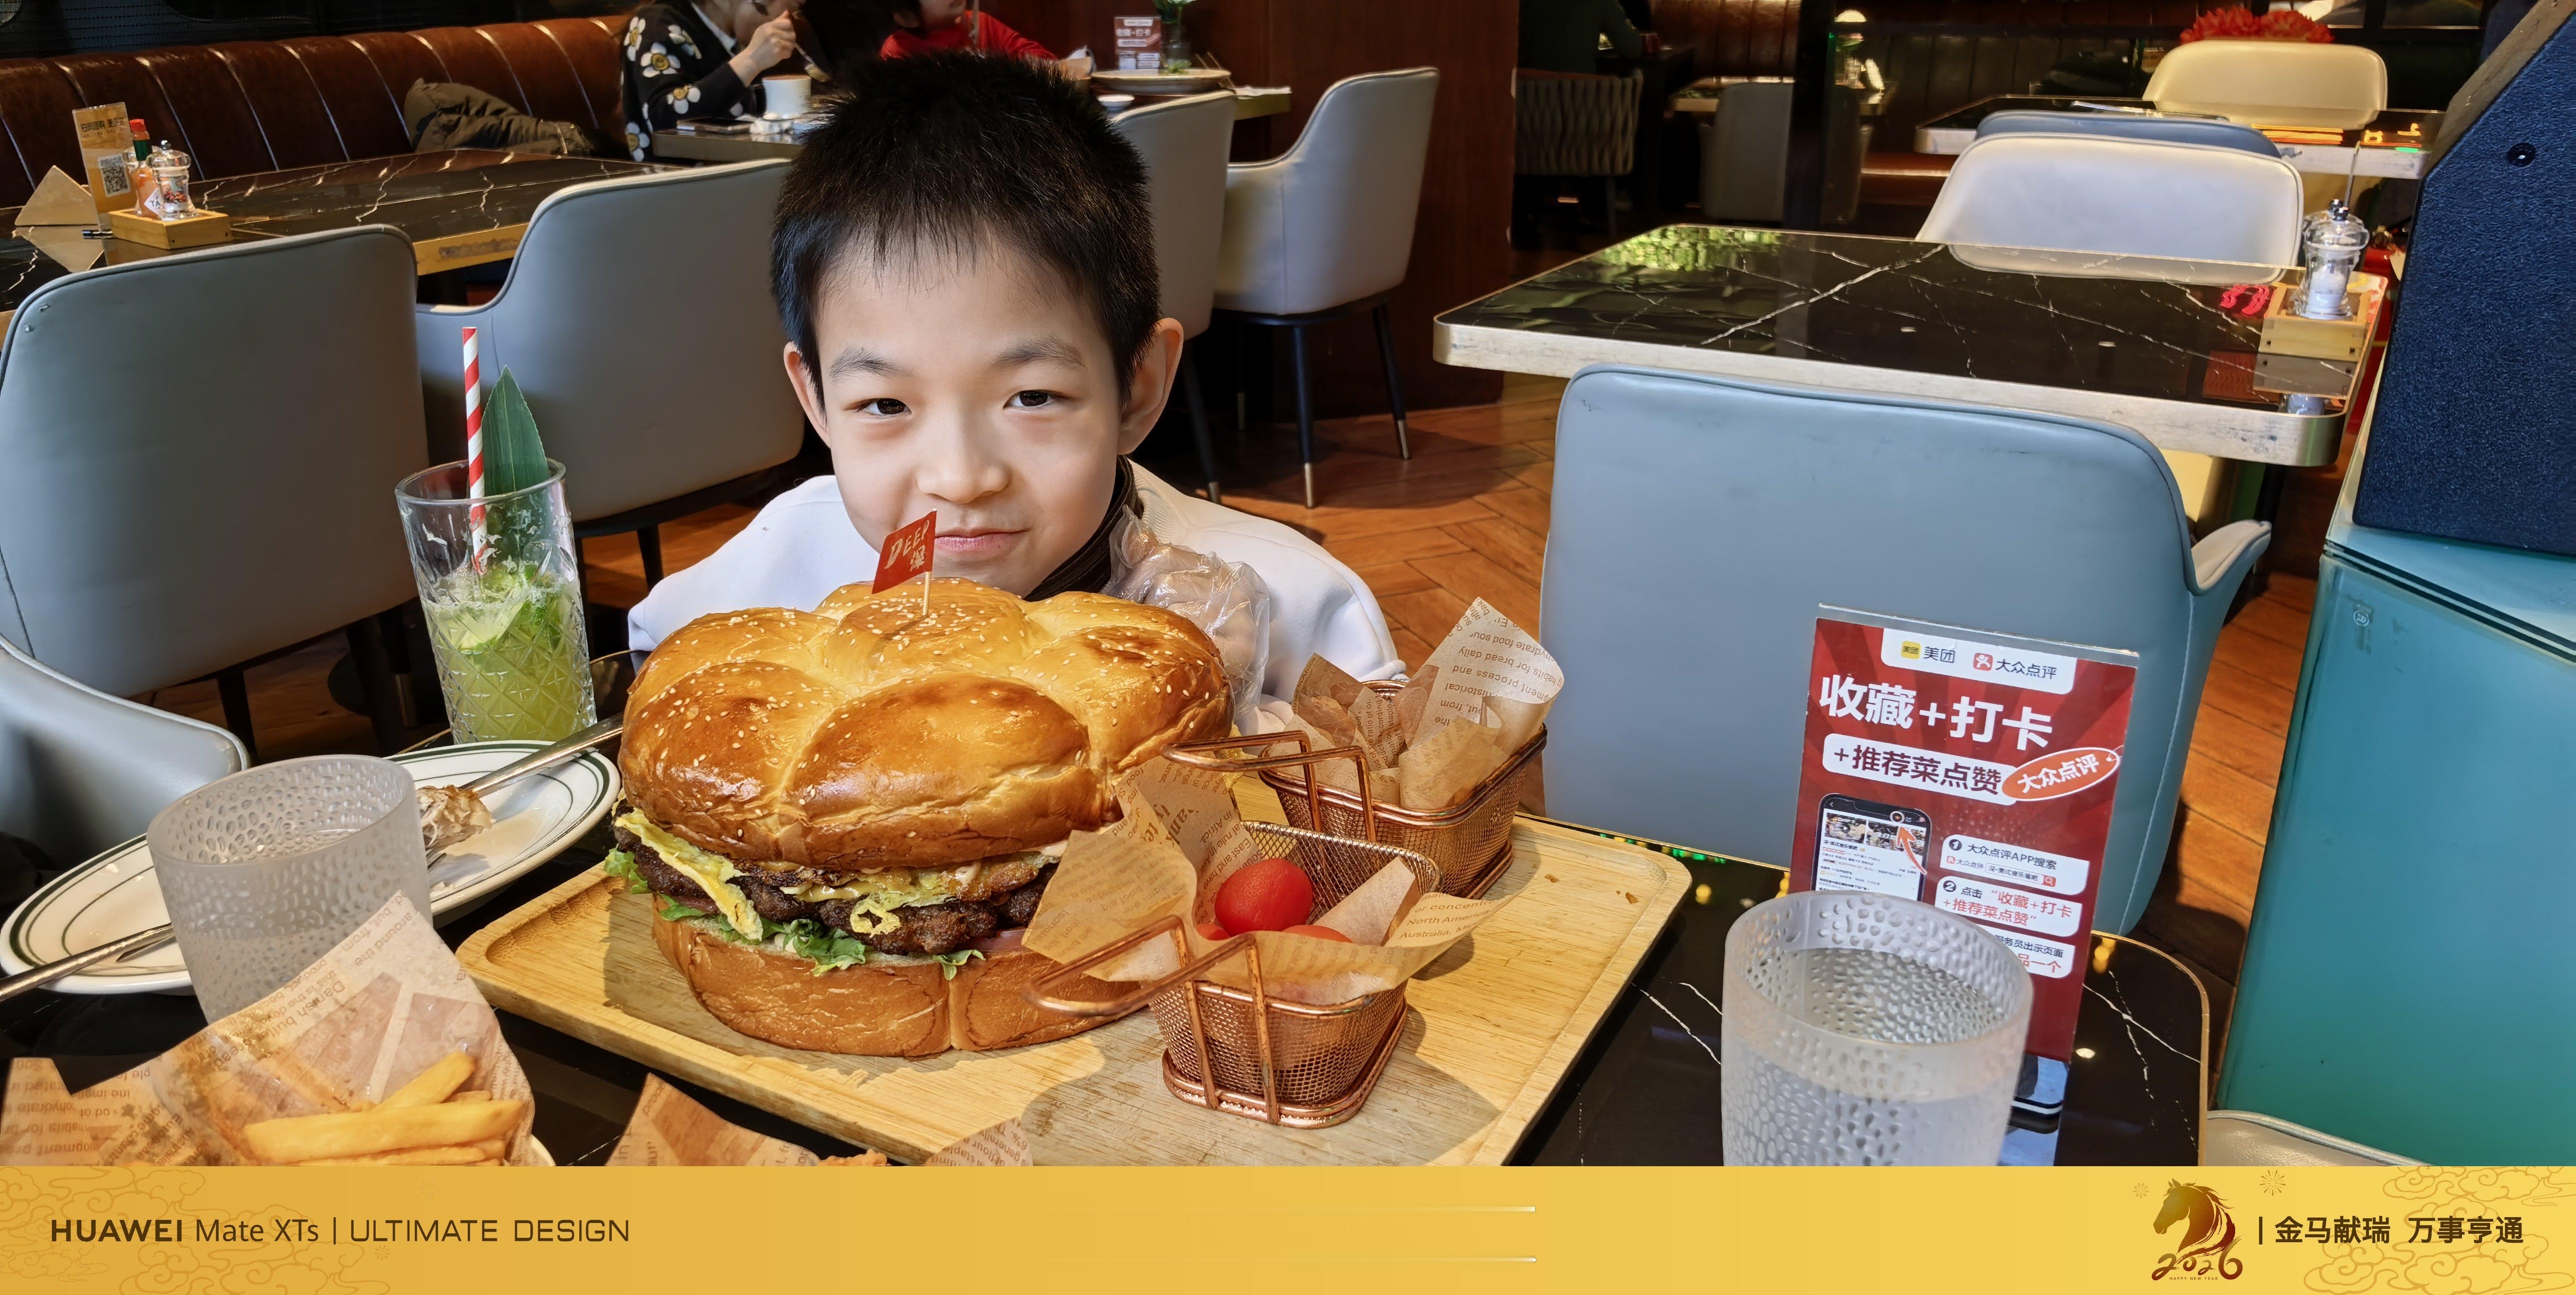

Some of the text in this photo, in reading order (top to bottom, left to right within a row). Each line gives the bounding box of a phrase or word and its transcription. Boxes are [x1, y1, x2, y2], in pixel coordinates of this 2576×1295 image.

[1491, 635, 1514, 648] food
[1452, 664, 1473, 676] and
[1457, 645, 1558, 685] habits for bread daily
[1924, 646, 1955, 663] 美团
[1996, 659, 2056, 679] 大众点评
[1475, 669, 1519, 688] process
[1439, 699, 1462, 711] from
[1819, 673, 2052, 751] 收藏+打卡
[1434, 716, 1450, 727] the
[1835, 744, 2001, 795] +推荐菜点赞
[2017, 753, 2100, 793] 大众点评
[1215, 831, 1234, 850] rule
[1230, 837, 1252, 859] East
[1216, 853, 1235, 873] and
[1967, 843, 2057, 870] 大众点评APP搜索
[1960, 886, 1983, 899] 点击
[1407, 916, 1439, 926] North
[373, 912, 415, 951] around
